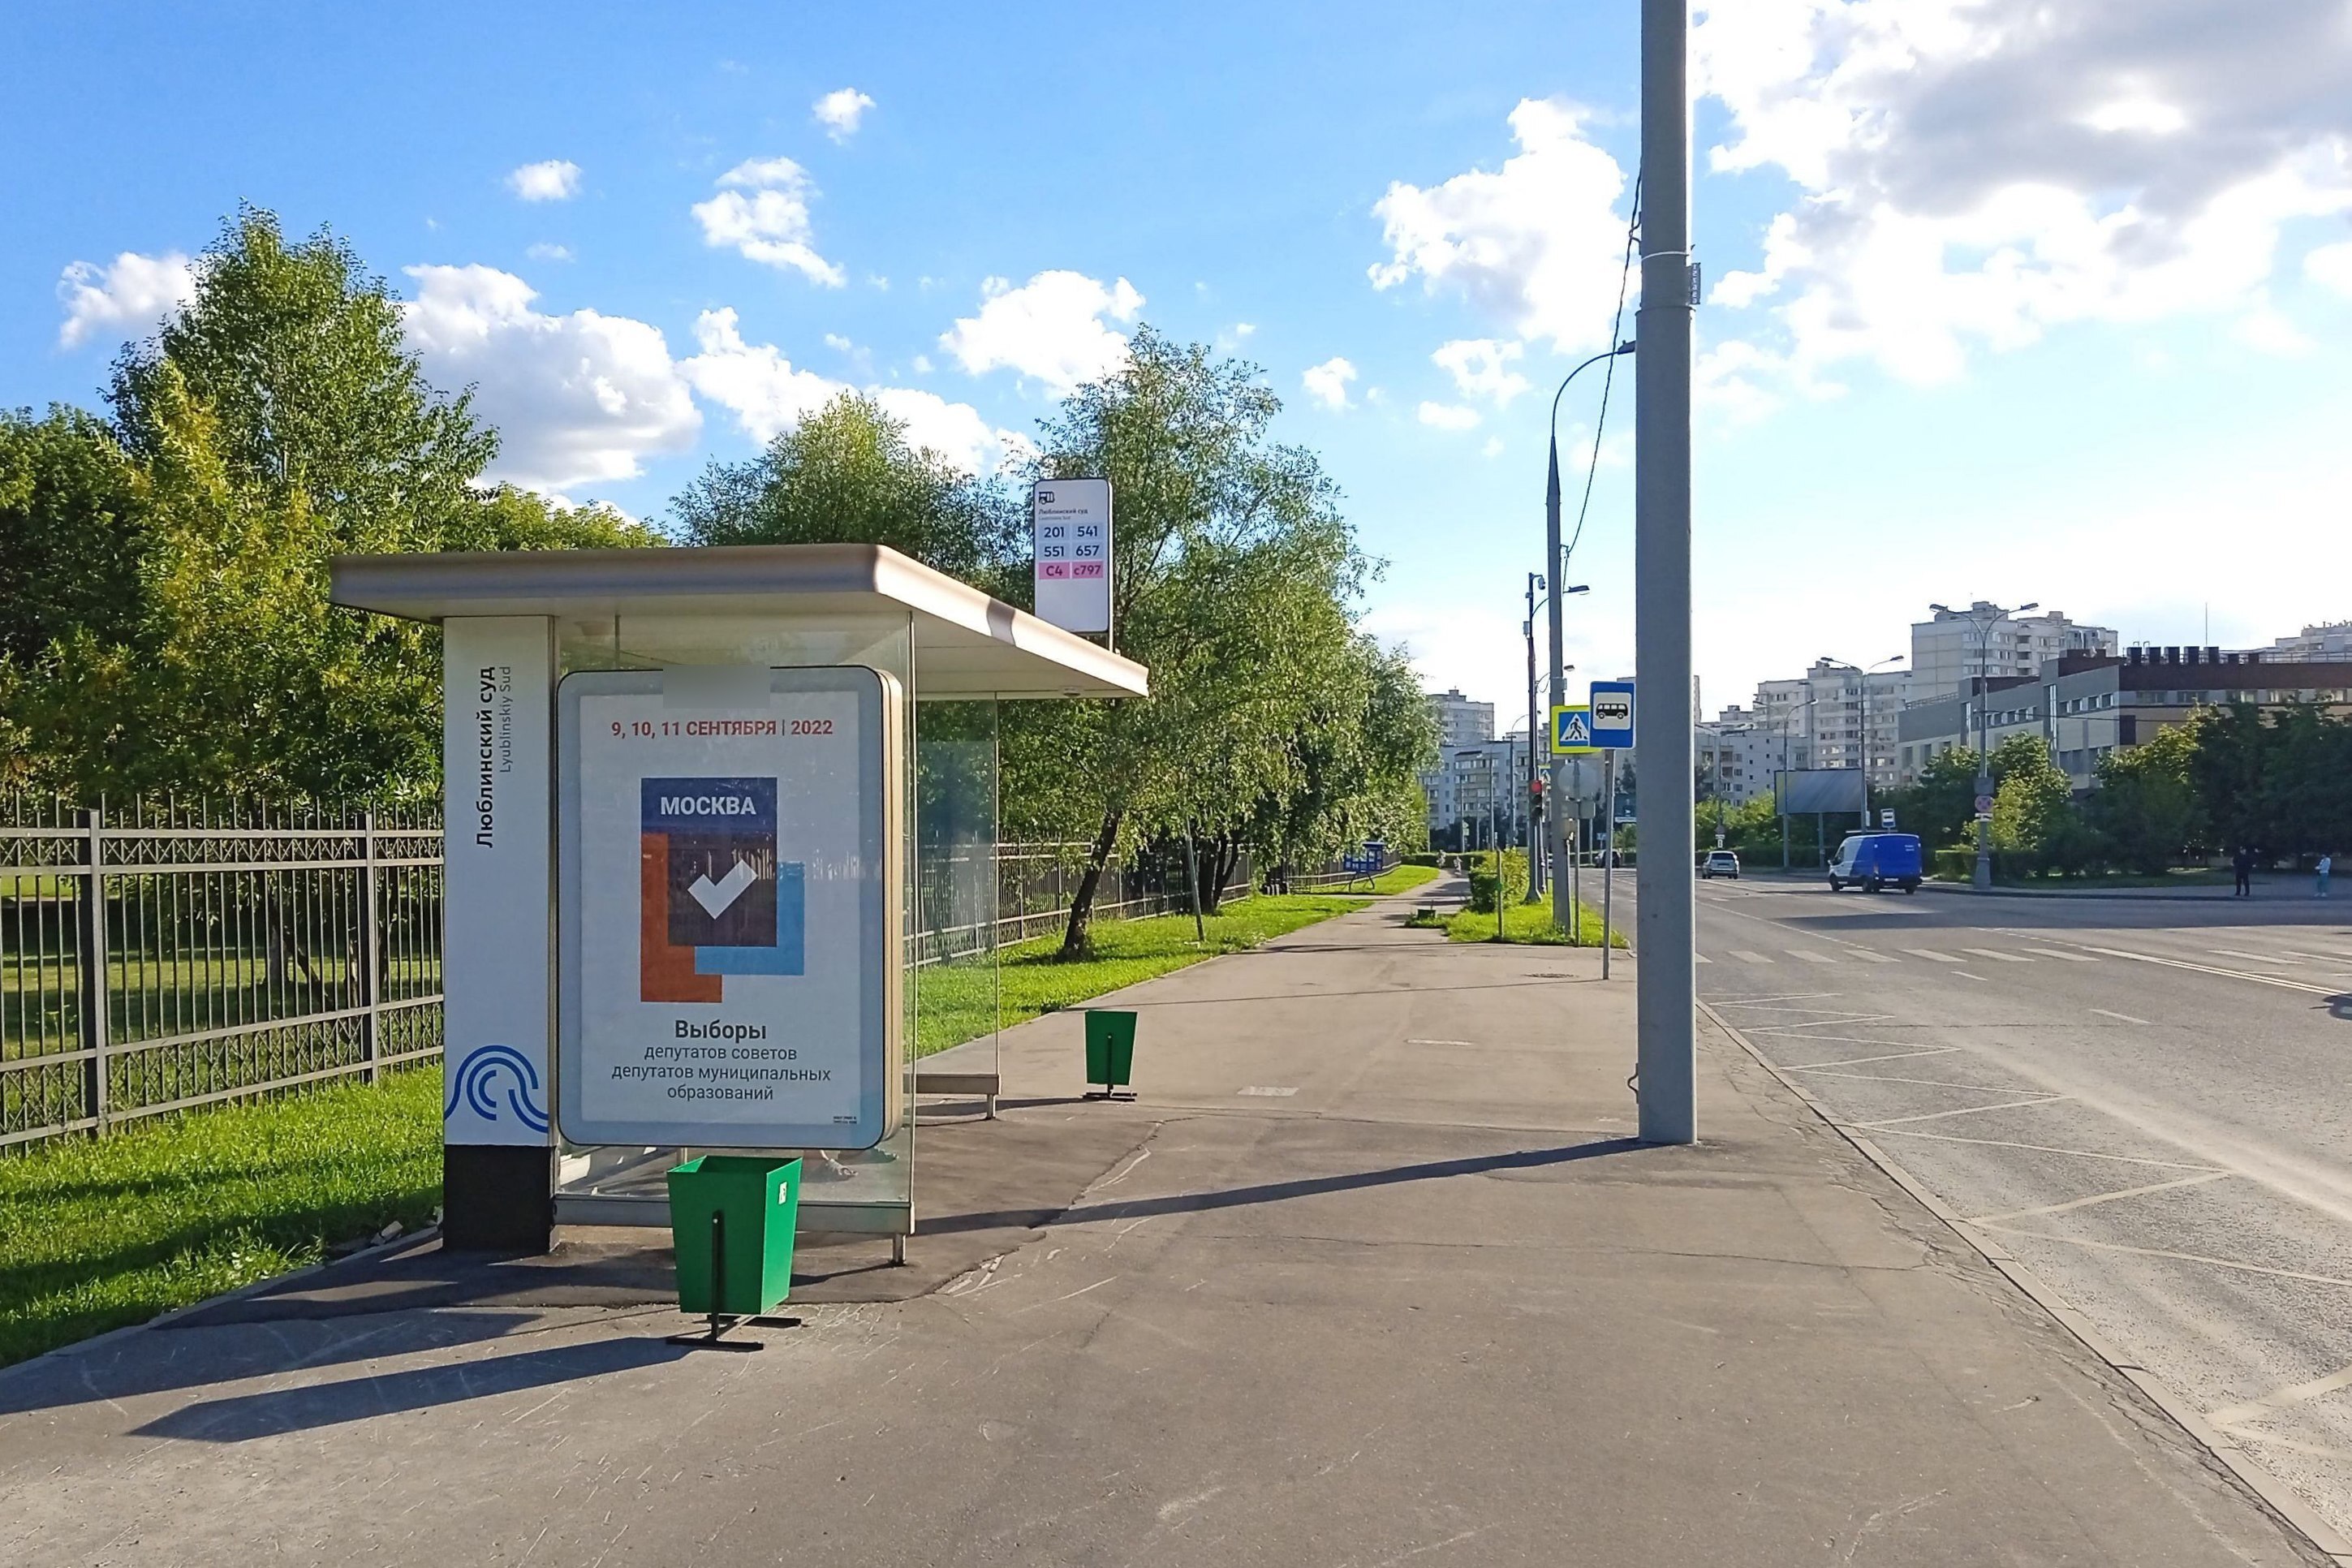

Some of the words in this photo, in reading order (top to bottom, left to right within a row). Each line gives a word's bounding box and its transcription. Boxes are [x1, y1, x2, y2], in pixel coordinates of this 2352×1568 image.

[1044, 526, 1064, 538] 201
[1077, 525, 1097, 537] 541
[1044, 545, 1064, 558] 551
[1075, 545, 1100, 557] 657
[1046, 565, 1063, 576] С4
[1074, 565, 1101, 575] с797
[480, 666, 497, 704] суд
[499, 666, 511, 692] Sud
[499, 696, 513, 773] Lyublinskiy
[611, 722, 626, 739] 9,
[631, 722, 656, 739] 10,
[661, 722, 679, 736] 11
[686, 720, 777, 736] СЕНТЯБРЯ
[790, 720, 834, 735] 2022
[476, 709, 493, 848] Люблинский
[661, 796, 756, 815] МОСКВА
[674, 1019, 767, 1044] Выборы
[644, 1046, 727, 1062] депутатов
[731, 1048, 797, 1060] советов
[611, 1066, 694, 1081] депутатов
[699, 1066, 831, 1083] муниципальных
[667, 1084, 773, 1101] образований
